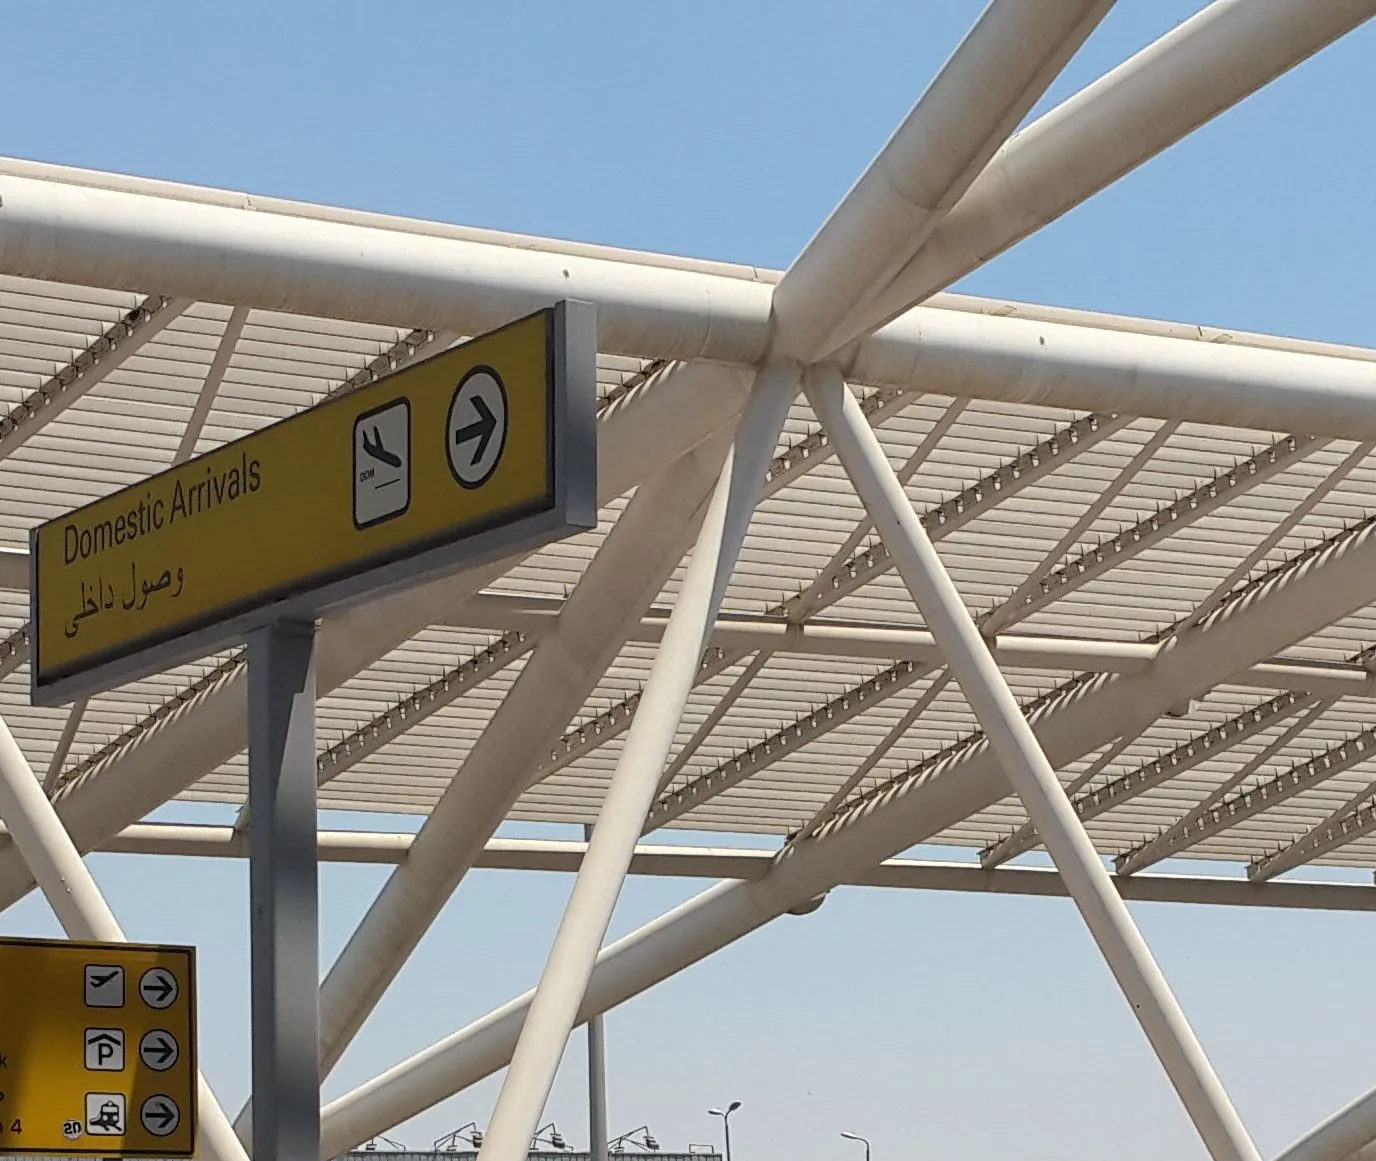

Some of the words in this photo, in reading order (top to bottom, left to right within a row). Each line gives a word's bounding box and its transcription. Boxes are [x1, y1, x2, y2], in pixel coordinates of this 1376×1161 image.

[64, 494, 164, 565] Domestic
[170, 451, 261, 524] Arrivals
[121, 562, 184, 610] وصول
[98, 1043, 114, 1065] P
[10, 1118, 22, 1135] 4
